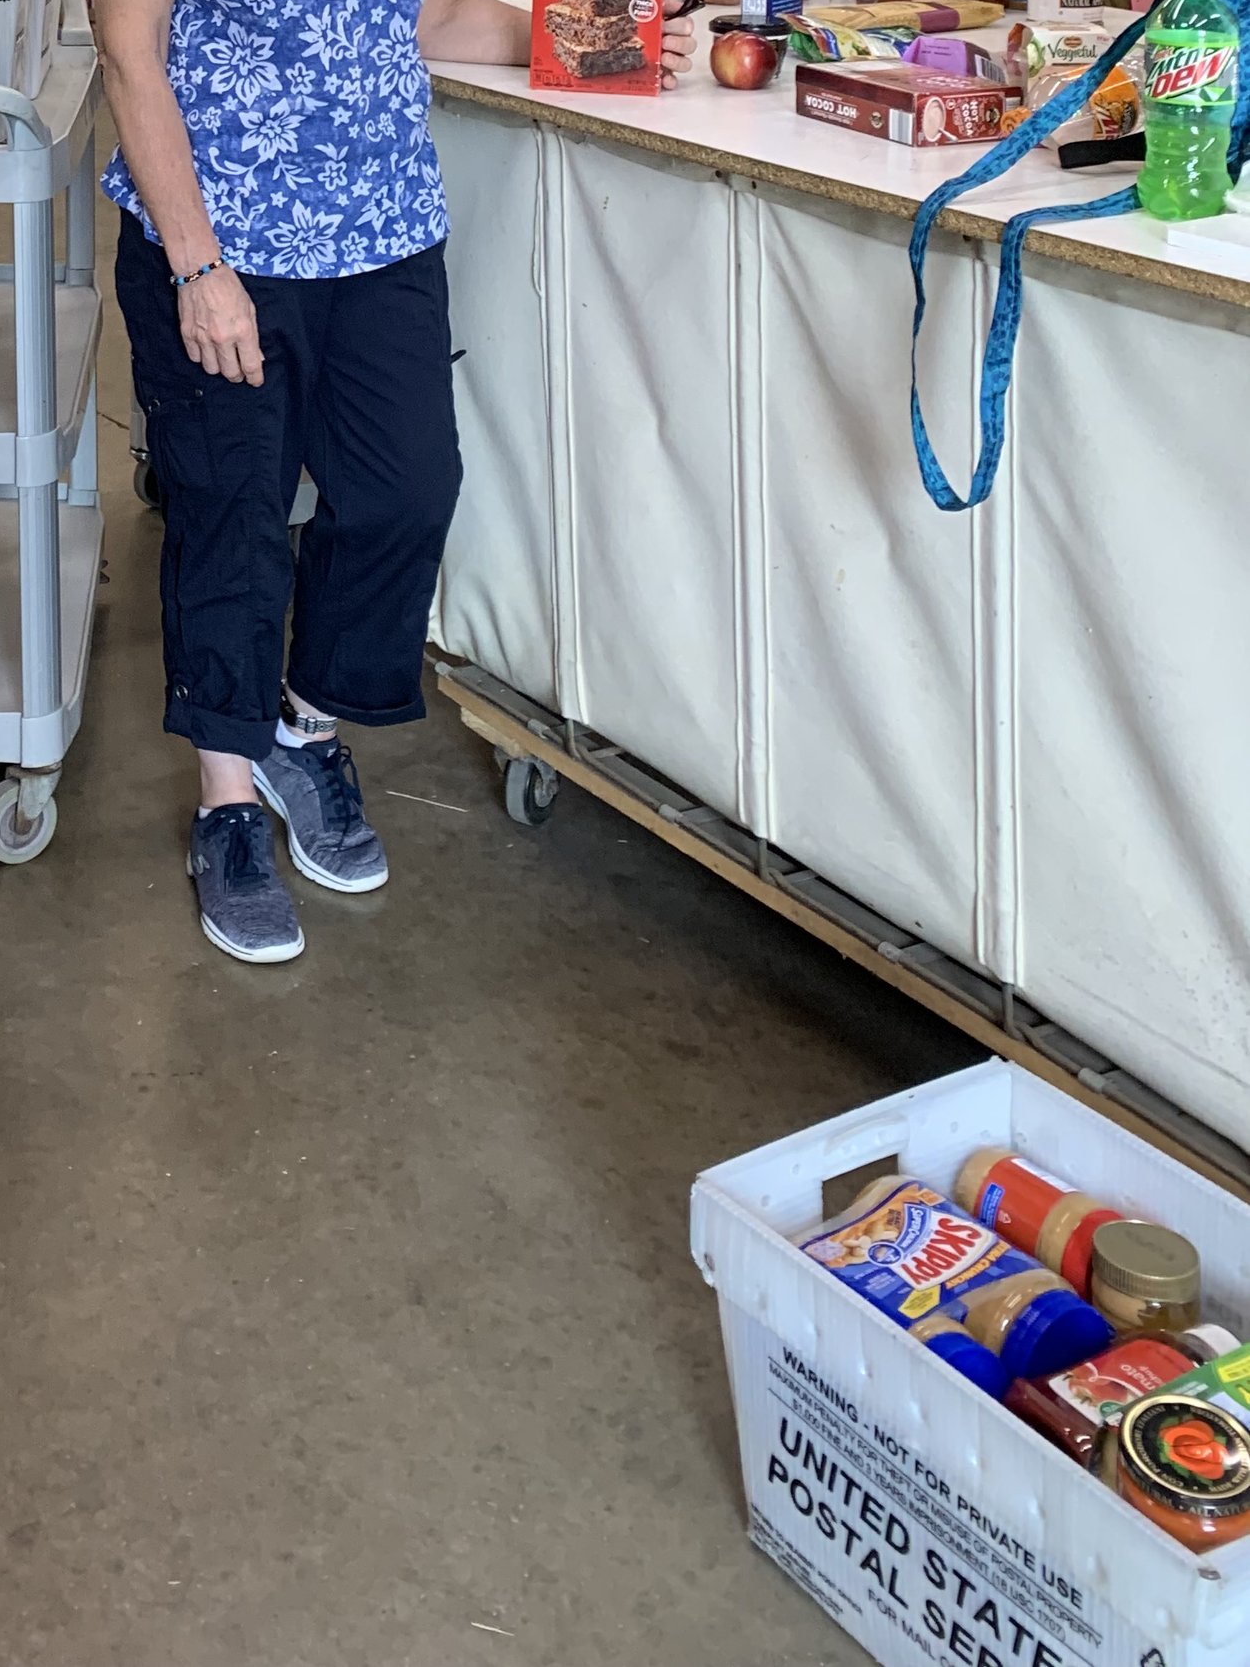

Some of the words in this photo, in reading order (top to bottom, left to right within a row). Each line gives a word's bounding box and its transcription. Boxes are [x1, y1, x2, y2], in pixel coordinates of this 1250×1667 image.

[806, 95, 835, 113] COCOA
[836, 104, 857, 119] HOT
[901, 1218, 981, 1285] SKIPPY
[768, 1454, 909, 1610] POSTAL
[769, 1363, 813, 1408] MAXIMUM
[814, 1401, 855, 1443] PENALTY
[857, 1438, 880, 1465] FOR
[881, 1457, 911, 1491] THEFT
[914, 1487, 928, 1507] OR
[930, 1500, 972, 1546] MISUSE
[973, 1539, 989, 1557] OF
[992, 1554, 1032, 1597] POSTAL
[1036, 1591, 1102, 1649] PROPERTY
[780, 1417, 910, 1555] UNITED
[783, 1346, 858, 1423] WARNING
[874, 1425, 910, 1465] NOT
[915, 1459, 951, 1503] FOR
[957, 1495, 1036, 1574] PRIVATE
[1042, 1564, 1083, 1611] USE
[844, 1445, 864, 1467] AND
[874, 1469, 907, 1506] YEARS
[908, 1501, 990, 1576] IMPRISONMENT
[1009, 1586, 1034, 1614] USC
[1037, 1608, 1066, 1643] 1707)
[868, 1588, 898, 1626] FOR
[901, 1620, 936, 1661] MAIL
